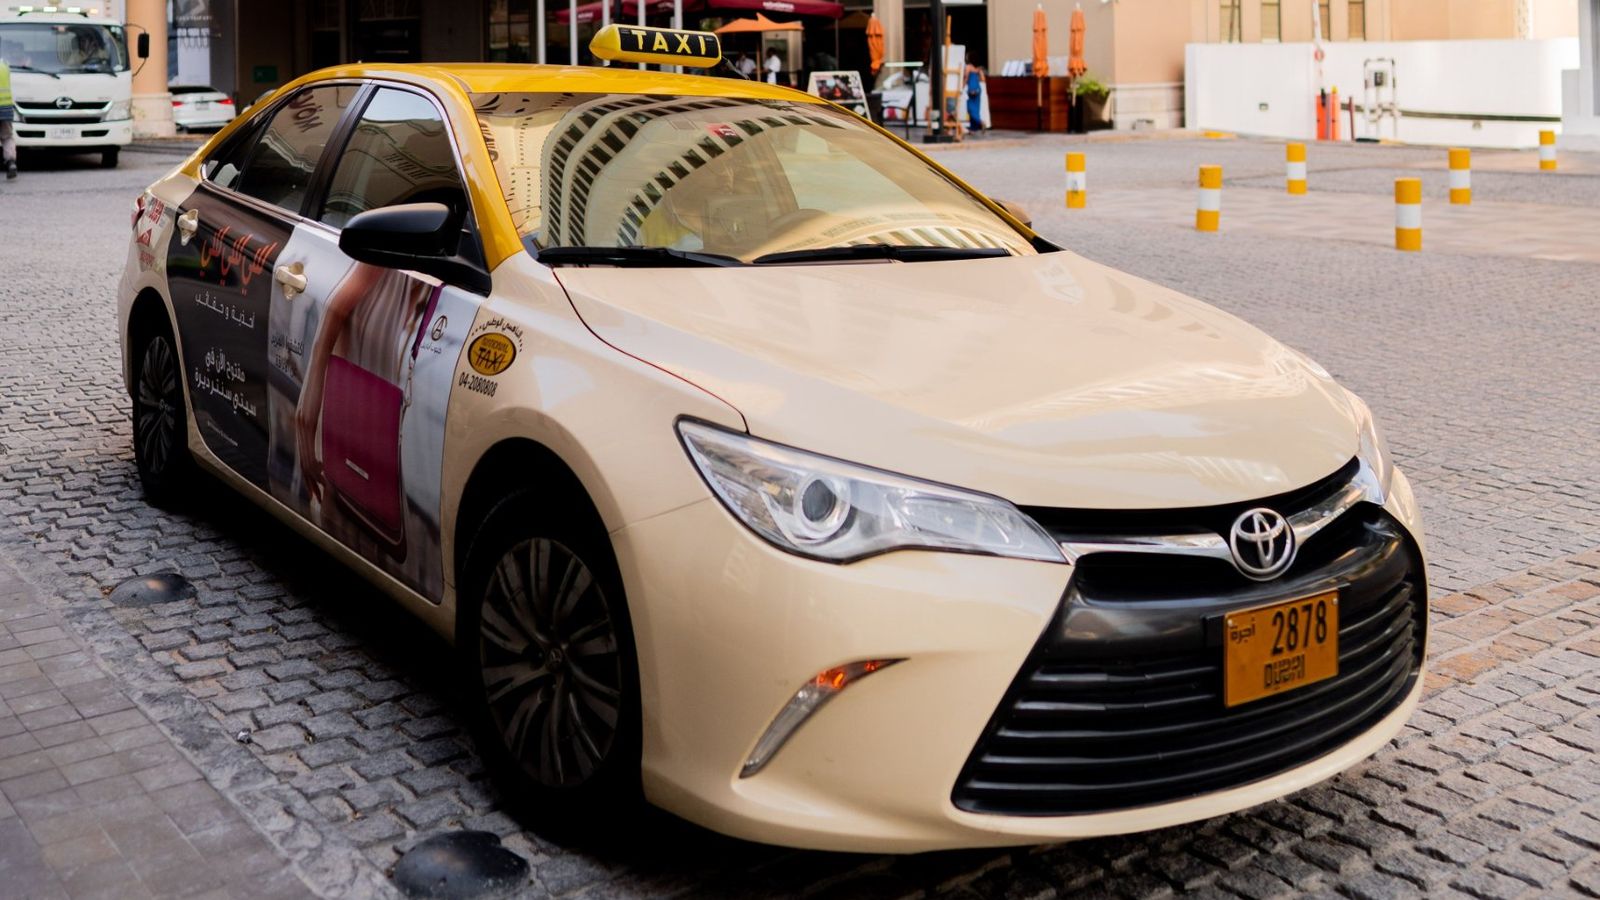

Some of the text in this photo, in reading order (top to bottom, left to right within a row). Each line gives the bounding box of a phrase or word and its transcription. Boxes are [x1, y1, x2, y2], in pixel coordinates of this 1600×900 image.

[630, 30, 706, 55] TAXI
[231, 304, 255, 328] أحذية
[474, 346, 507, 371] TAXI
[226, 362, 246, 382] مفتوح
[458, 372, 498, 397] 04-2080808
[210, 378, 233, 401] سنتر
[232, 393, 257, 417] سيتي
[1230, 617, 1256, 645] أجرة
[1271, 600, 1328, 656] 2878
